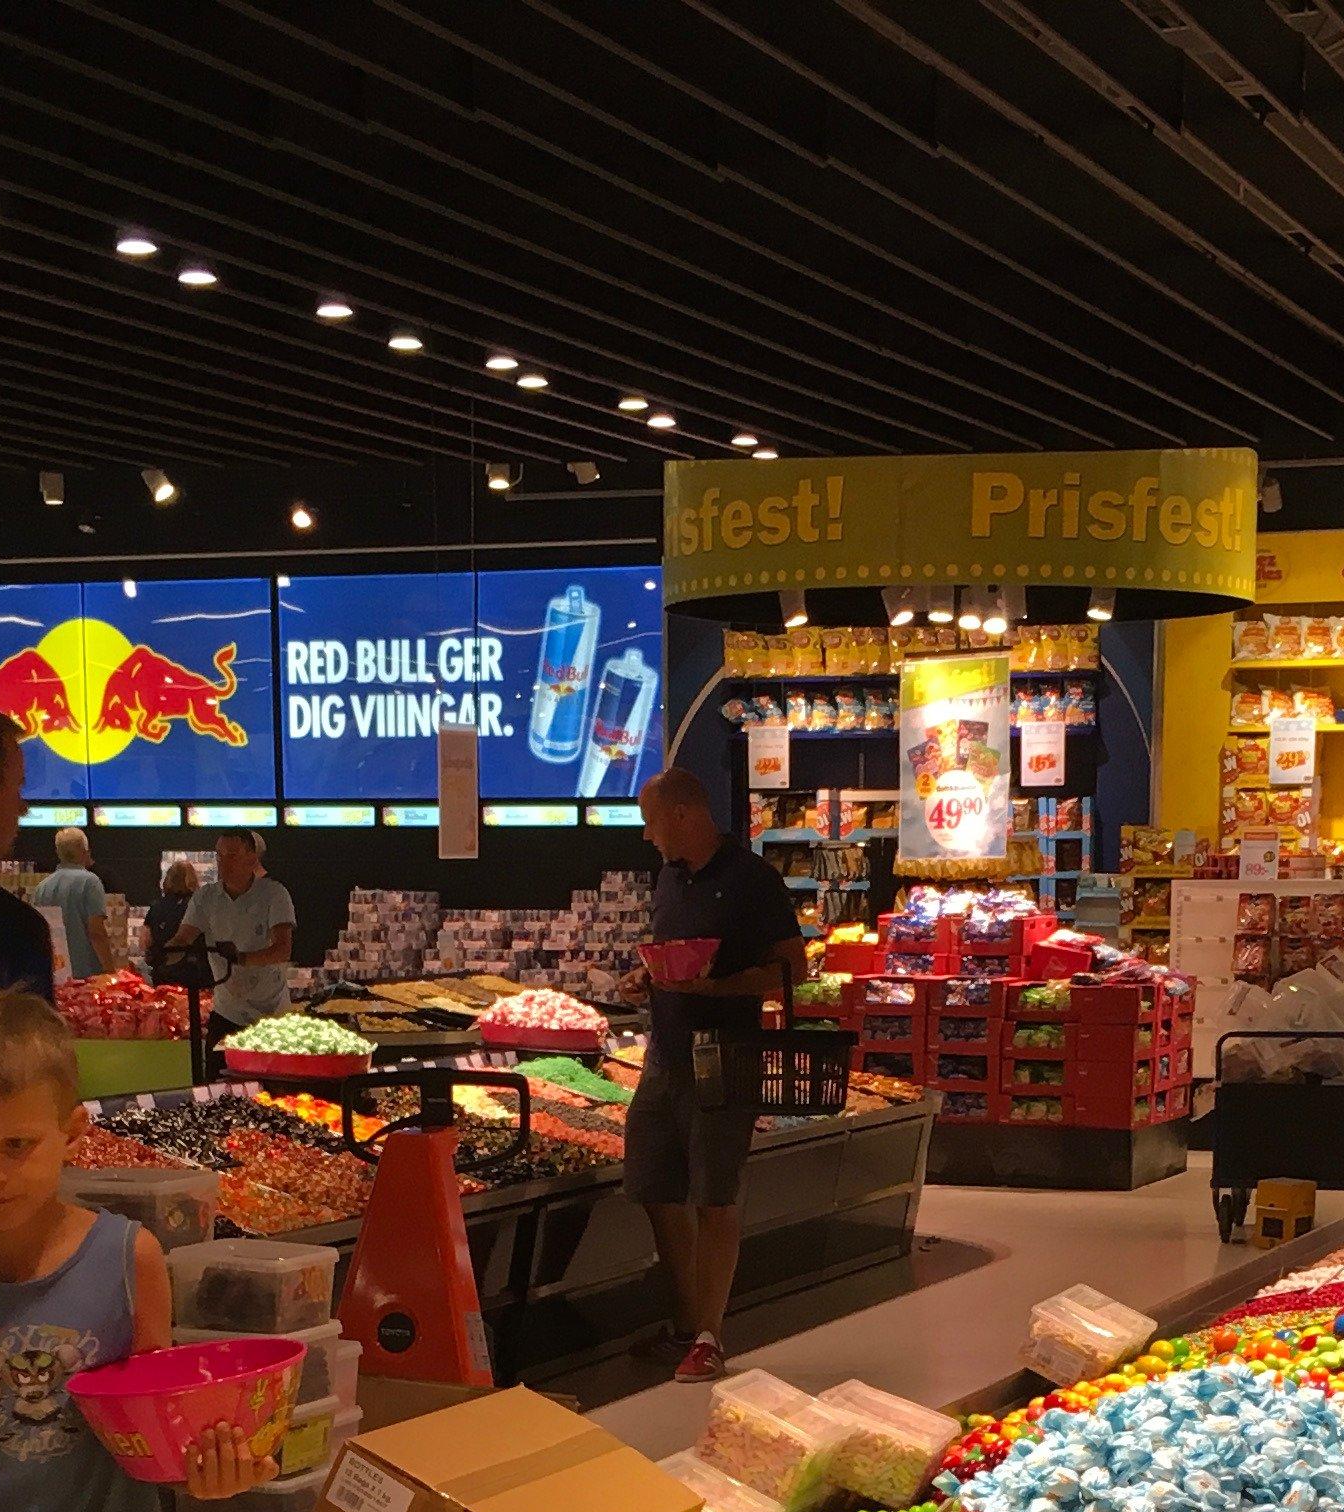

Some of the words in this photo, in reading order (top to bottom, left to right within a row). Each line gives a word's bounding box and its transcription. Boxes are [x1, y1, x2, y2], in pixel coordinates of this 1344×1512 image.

[970, 471, 1244, 554] Prisfest!
[287, 640, 348, 685] RED
[356, 638, 436, 684] BULL
[439, 636, 504, 682] GER
[289, 695, 345, 739] DIG
[349, 1457, 383, 1484] BOTTLES
